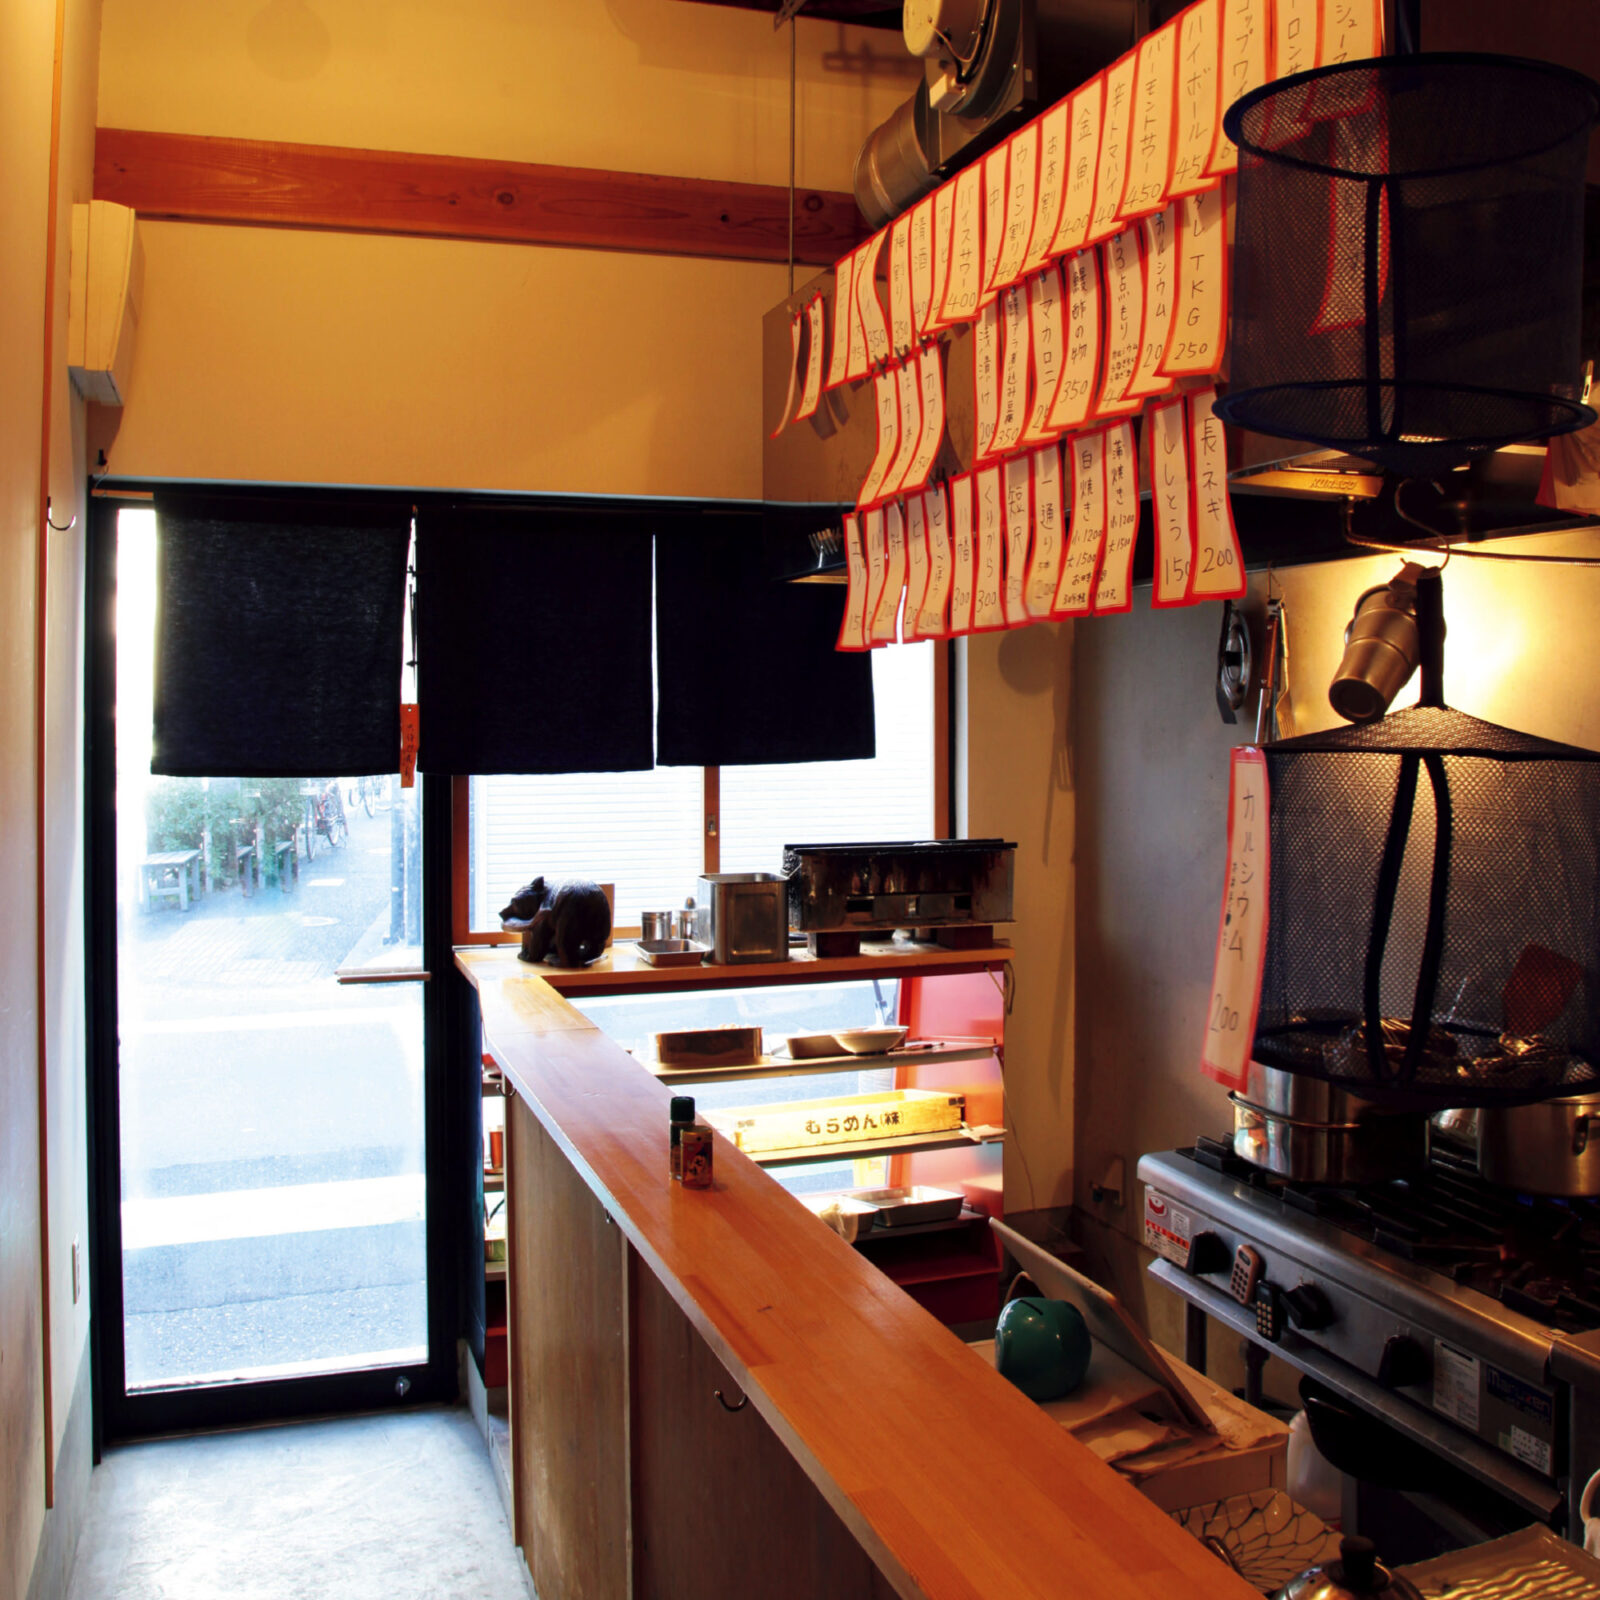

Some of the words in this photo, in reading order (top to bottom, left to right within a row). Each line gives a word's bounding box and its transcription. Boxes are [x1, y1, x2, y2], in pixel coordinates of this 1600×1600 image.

[1175, 155, 1200, 184] 45
[1124, 183, 1162, 207] 450
[1094, 203, 1117, 224] 40
[1039, 298, 1057, 386] マカロニ
[1142, 343, 1164, 369] 20
[1173, 342, 1209, 361] 250
[1062, 380, 1089, 404] 350
[1200, 416, 1224, 522] 長ネギ
[1079, 451, 1094, 522] 白焼き
[1163, 433, 1183, 542] ししとう
[982, 485, 997, 578] くりから
[1201, 547, 1234, 574] 200
[976, 590, 997, 614] 300
[1209, 993, 1240, 1033] 200
